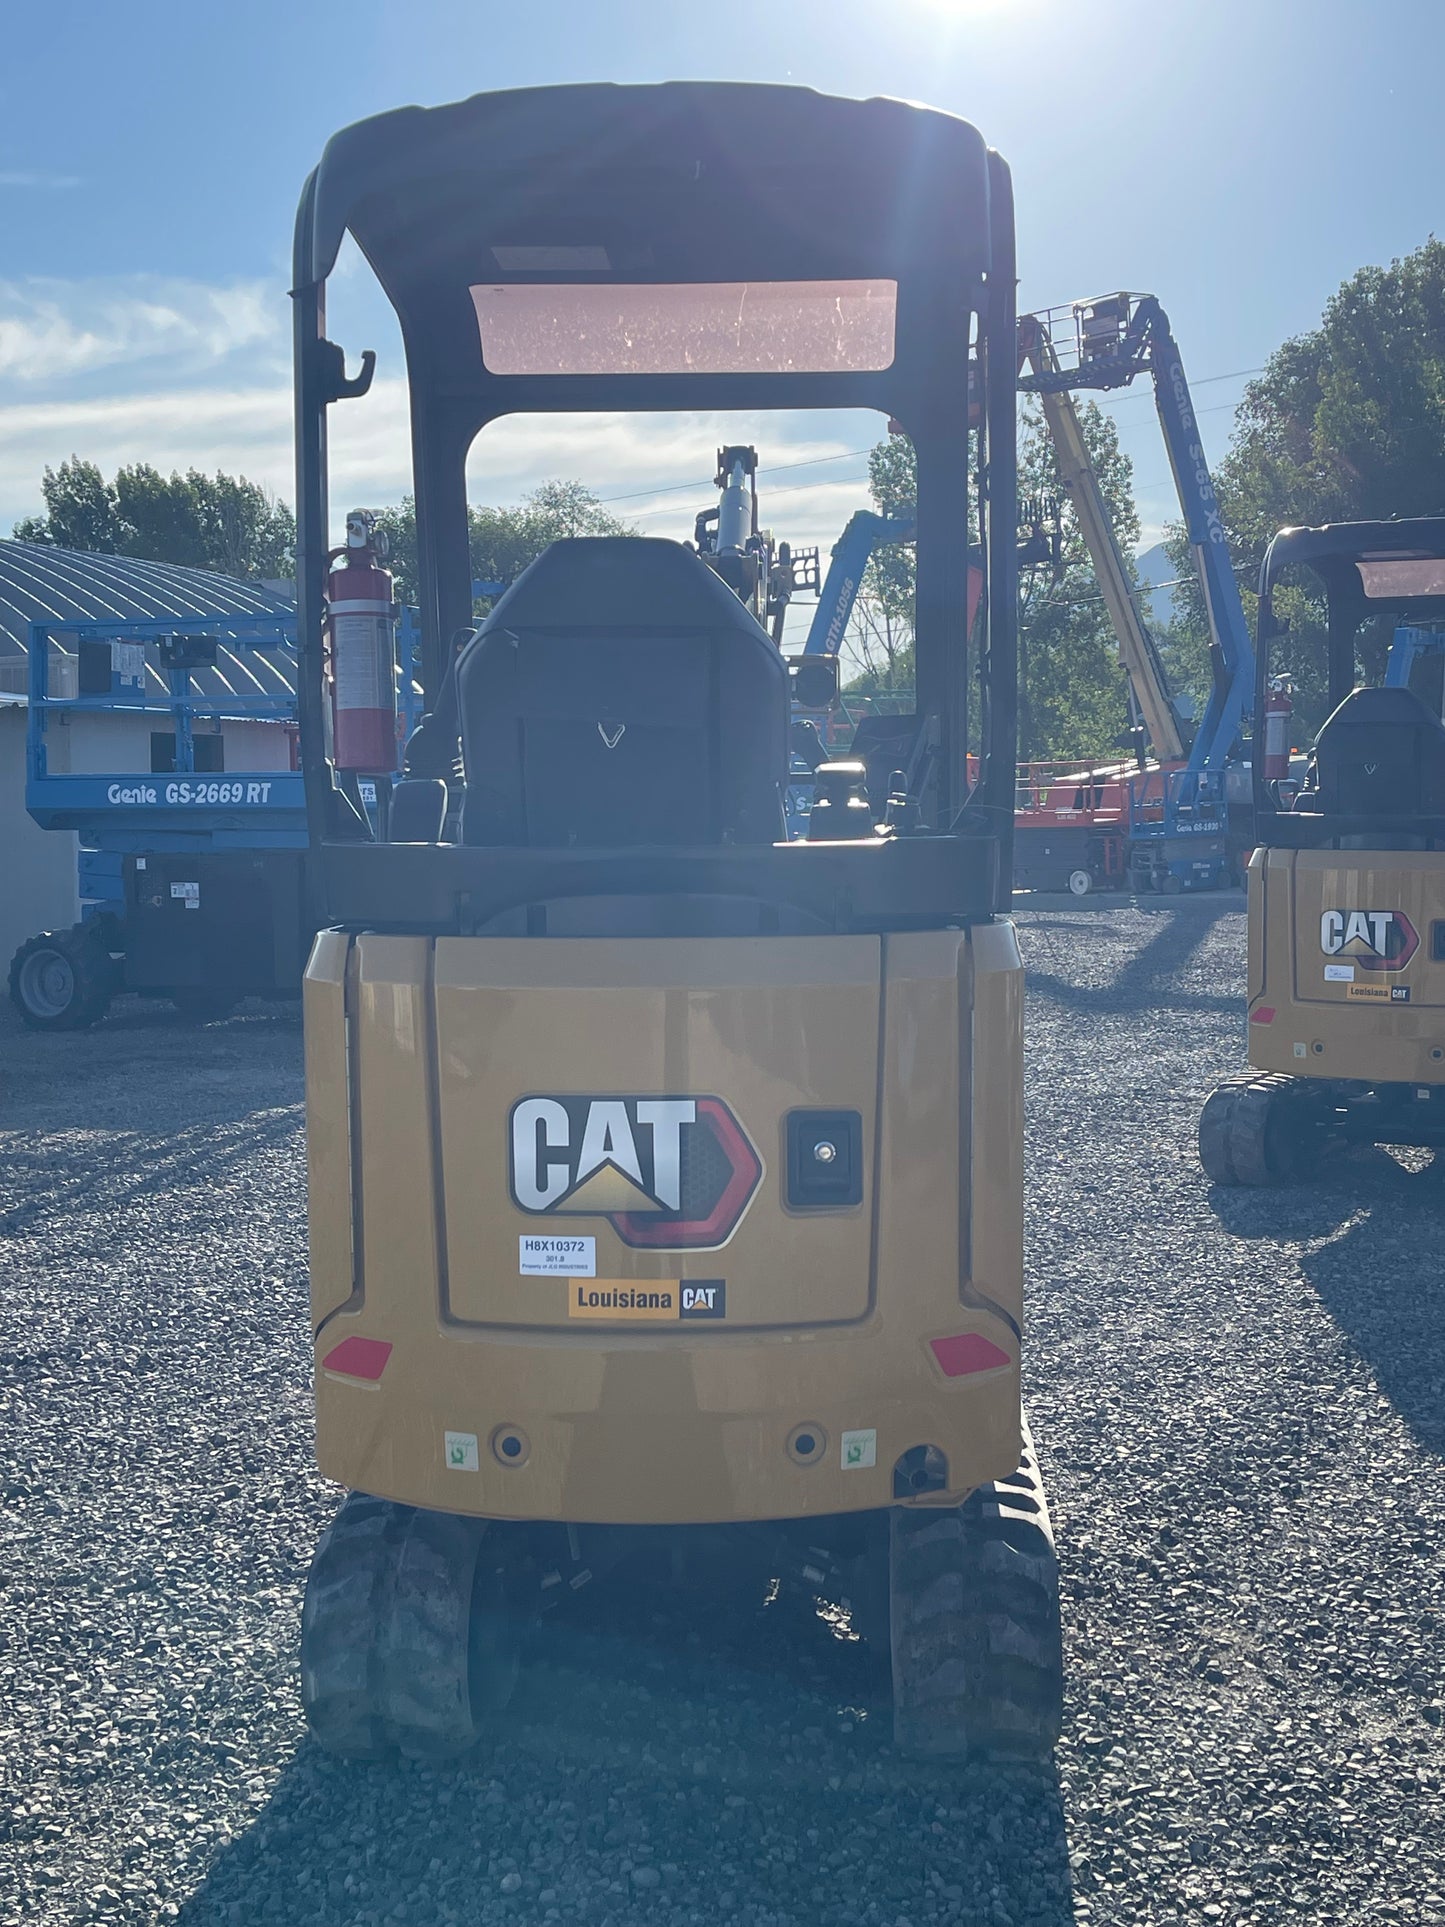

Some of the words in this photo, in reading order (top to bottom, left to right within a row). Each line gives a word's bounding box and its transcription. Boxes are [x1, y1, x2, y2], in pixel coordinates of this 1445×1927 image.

[1169, 361, 1193, 431] Genie
[1189, 443, 1214, 500] S-65
[1203, 507, 1225, 544] XC
[825, 576, 854, 652] GTH-1056
[107, 783, 157, 804] Genie
[165, 782, 243, 804] GS-2669
[246, 782, 272, 804] RT
[1321, 910, 1393, 957] CAT
[1350, 987, 1389, 997] Louisiana
[1392, 989, 1407, 998] CAT
[513, 1098, 696, 1211] CAT
[525, 1240, 585, 1252] H8X10372
[578, 1287, 672, 1309] Louisiana
[682, 1288, 716, 1310] CAT
